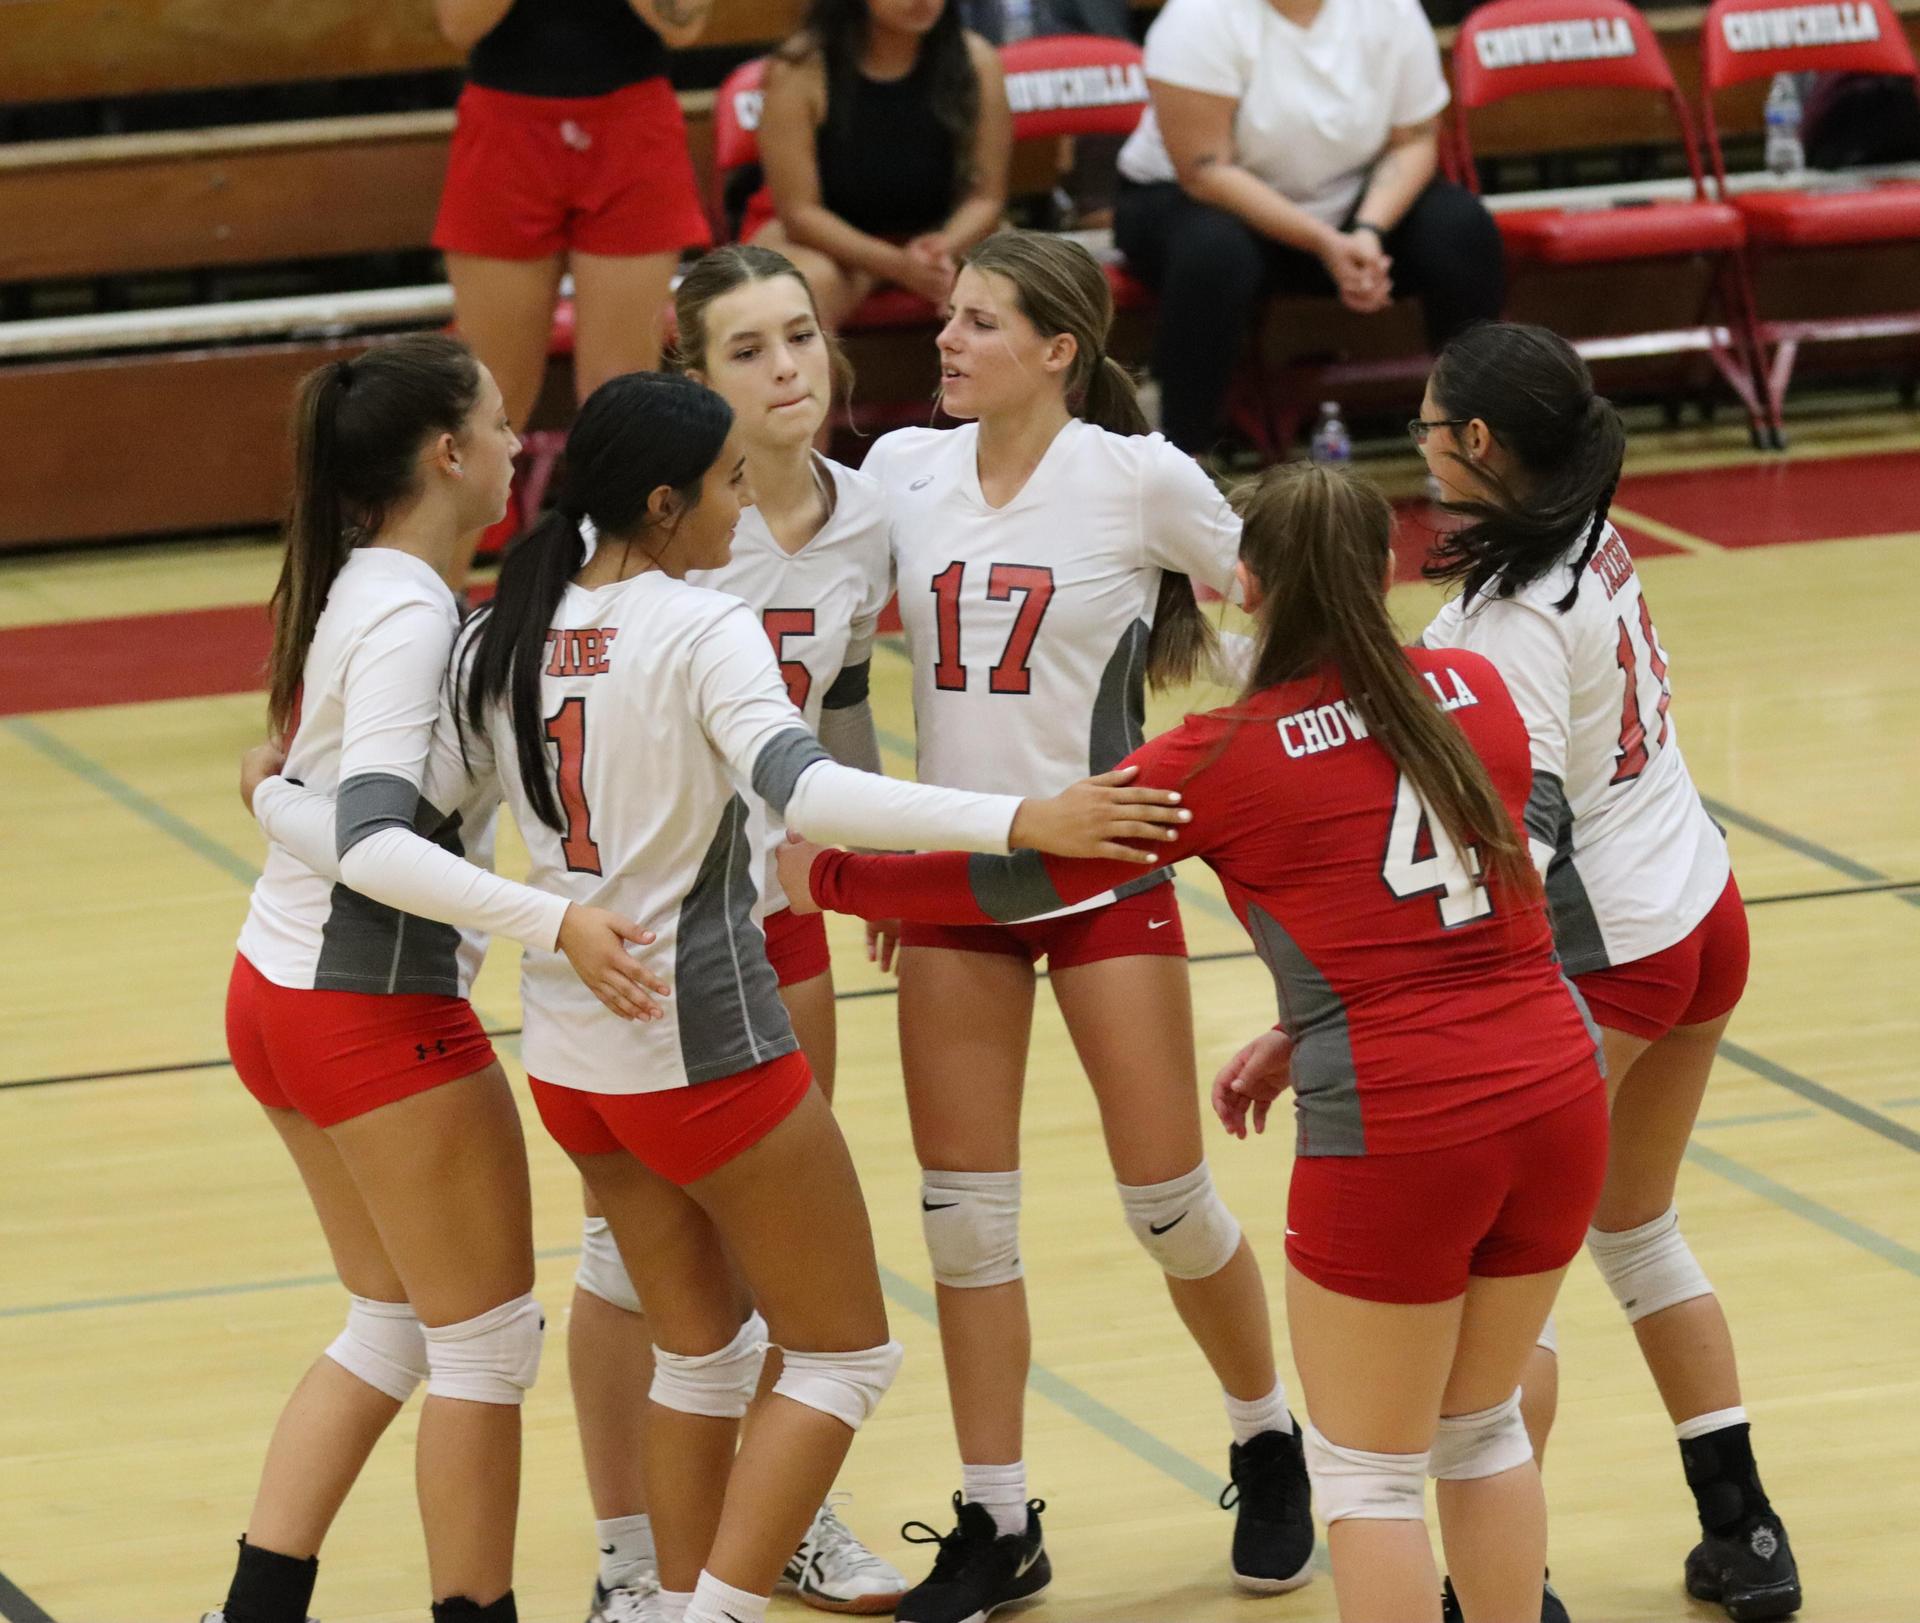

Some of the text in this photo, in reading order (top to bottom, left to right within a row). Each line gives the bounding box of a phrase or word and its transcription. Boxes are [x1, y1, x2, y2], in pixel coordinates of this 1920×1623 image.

[1004, 63, 1149, 113] HOWCHILLA
[1474, 16, 1637, 70] CHOWCHILLA
[930, 560, 1056, 695] 17
[1277, 667, 1479, 759] CHOWLA
[545, 696, 603, 877] 1
[1381, 768, 1494, 931] 4
